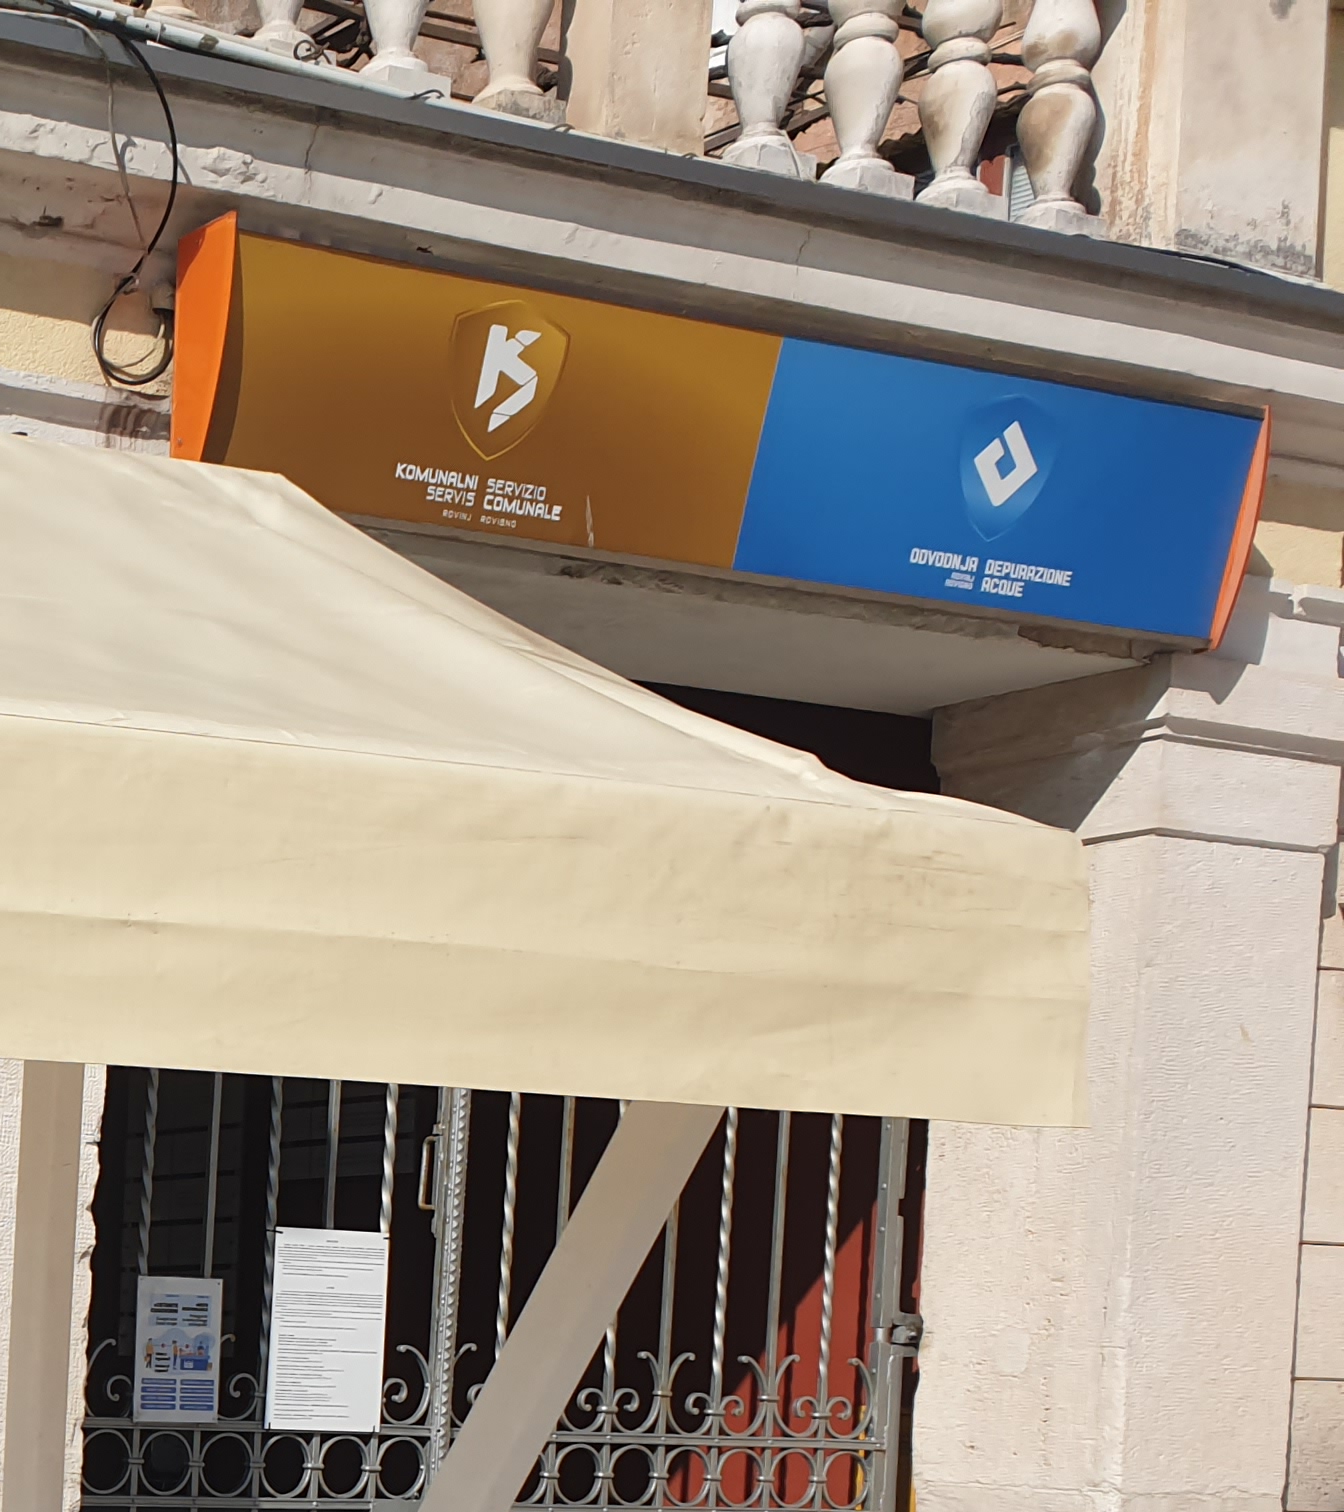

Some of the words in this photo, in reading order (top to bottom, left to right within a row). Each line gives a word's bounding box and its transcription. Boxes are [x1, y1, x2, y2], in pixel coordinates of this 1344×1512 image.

[395, 462, 479, 490] KOMUNALNI
[426, 486, 476, 507] SERVIS
[486, 478, 547, 500] SERVIZIO
[483, 495, 562, 521] COMUNALE
[909, 548, 979, 573] ODVODNJA
[984, 559, 1073, 586] DEPURAZIONE
[980, 577, 1025, 597] ACQUE
